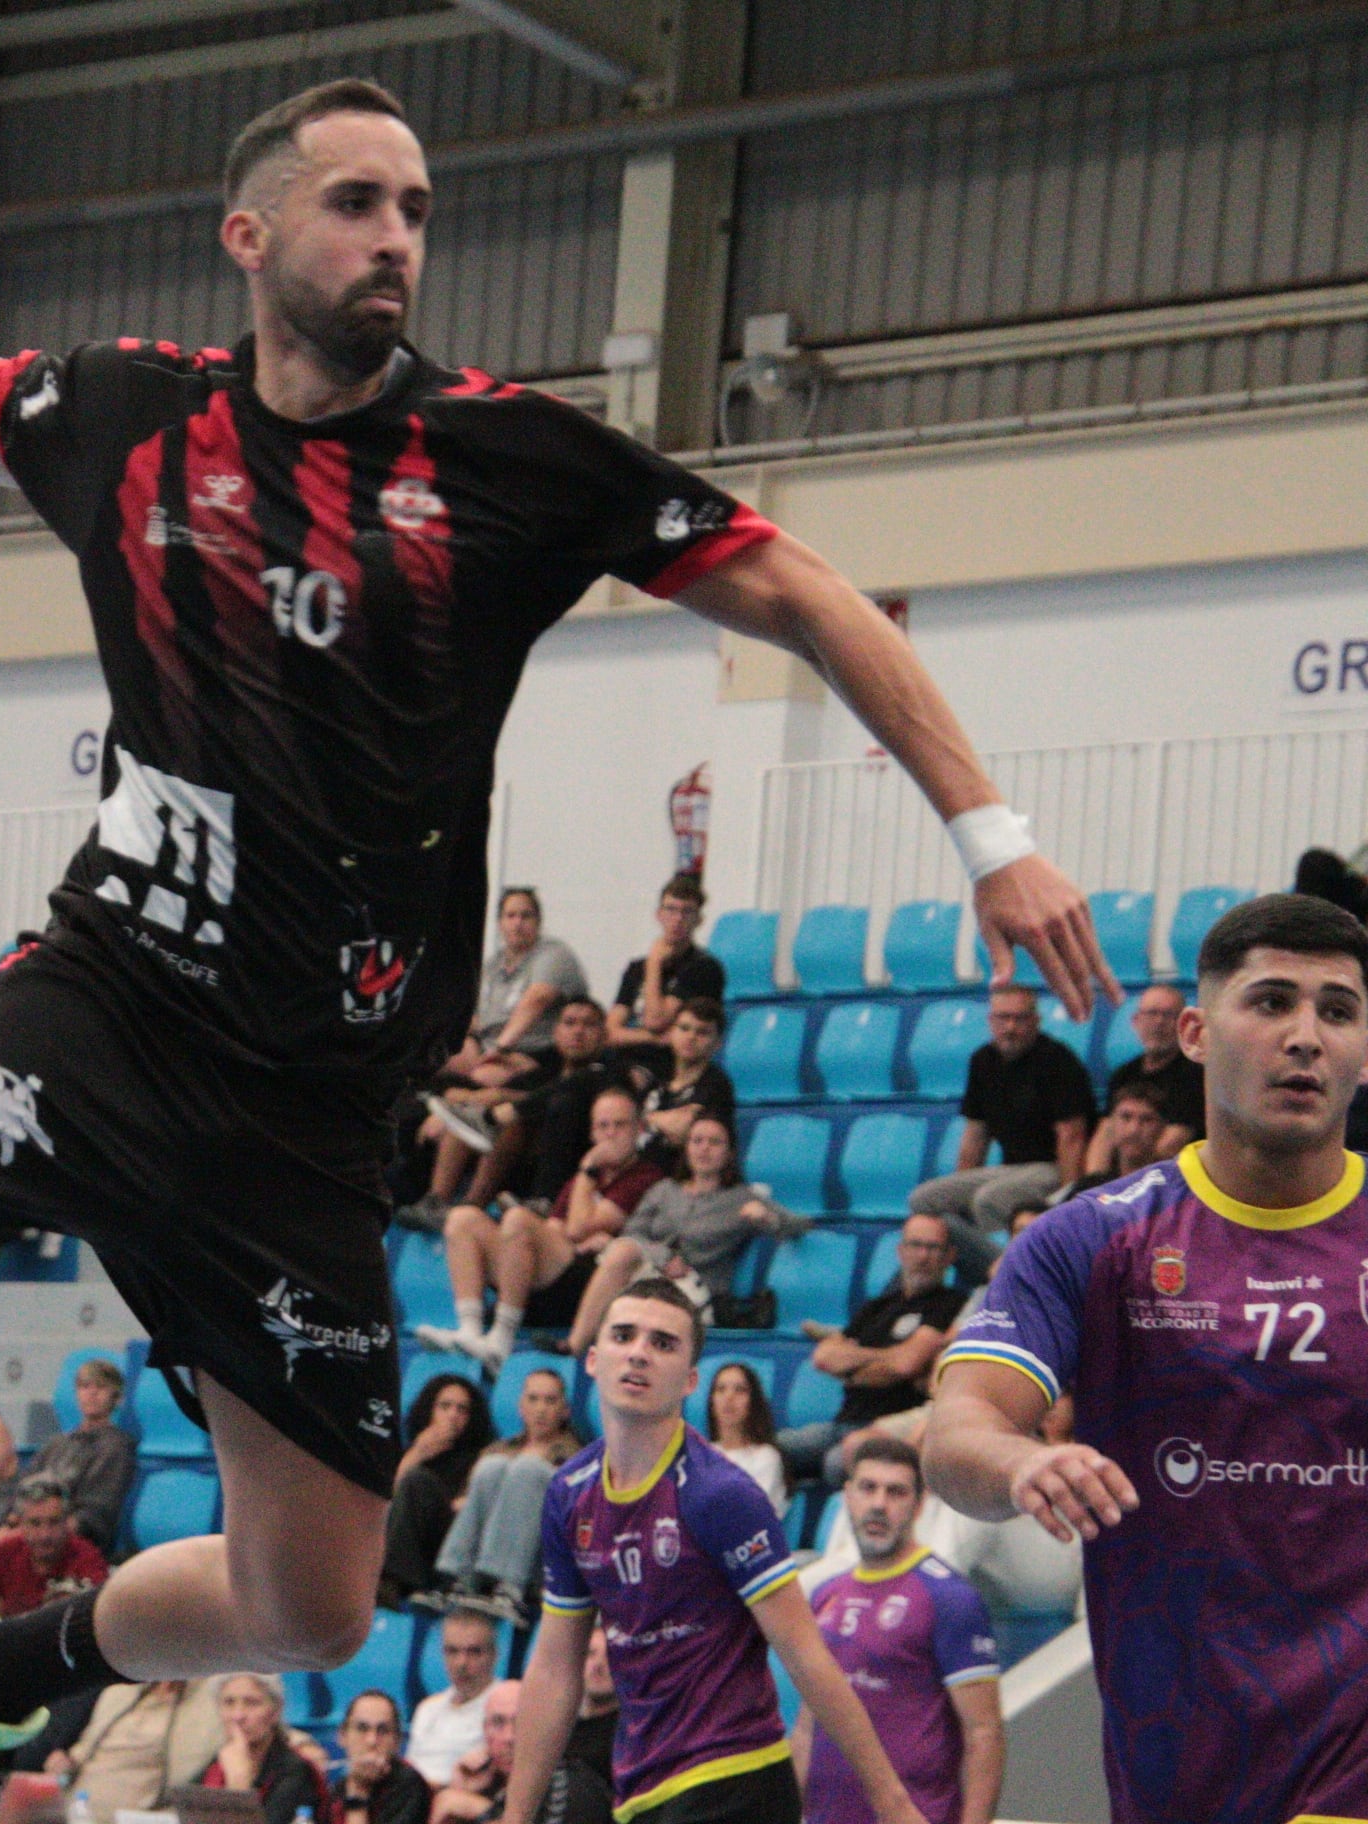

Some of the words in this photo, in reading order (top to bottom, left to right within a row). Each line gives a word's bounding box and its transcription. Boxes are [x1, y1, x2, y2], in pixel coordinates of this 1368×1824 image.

[258, 566, 348, 649] 10
[1293, 642, 1368, 694] GR
[1128, 1317, 1219, 1331] ACORONTE
[1244, 1302, 1327, 1362] 72
[612, 1546, 642, 1584] 10
[839, 1607, 861, 1637] 5
